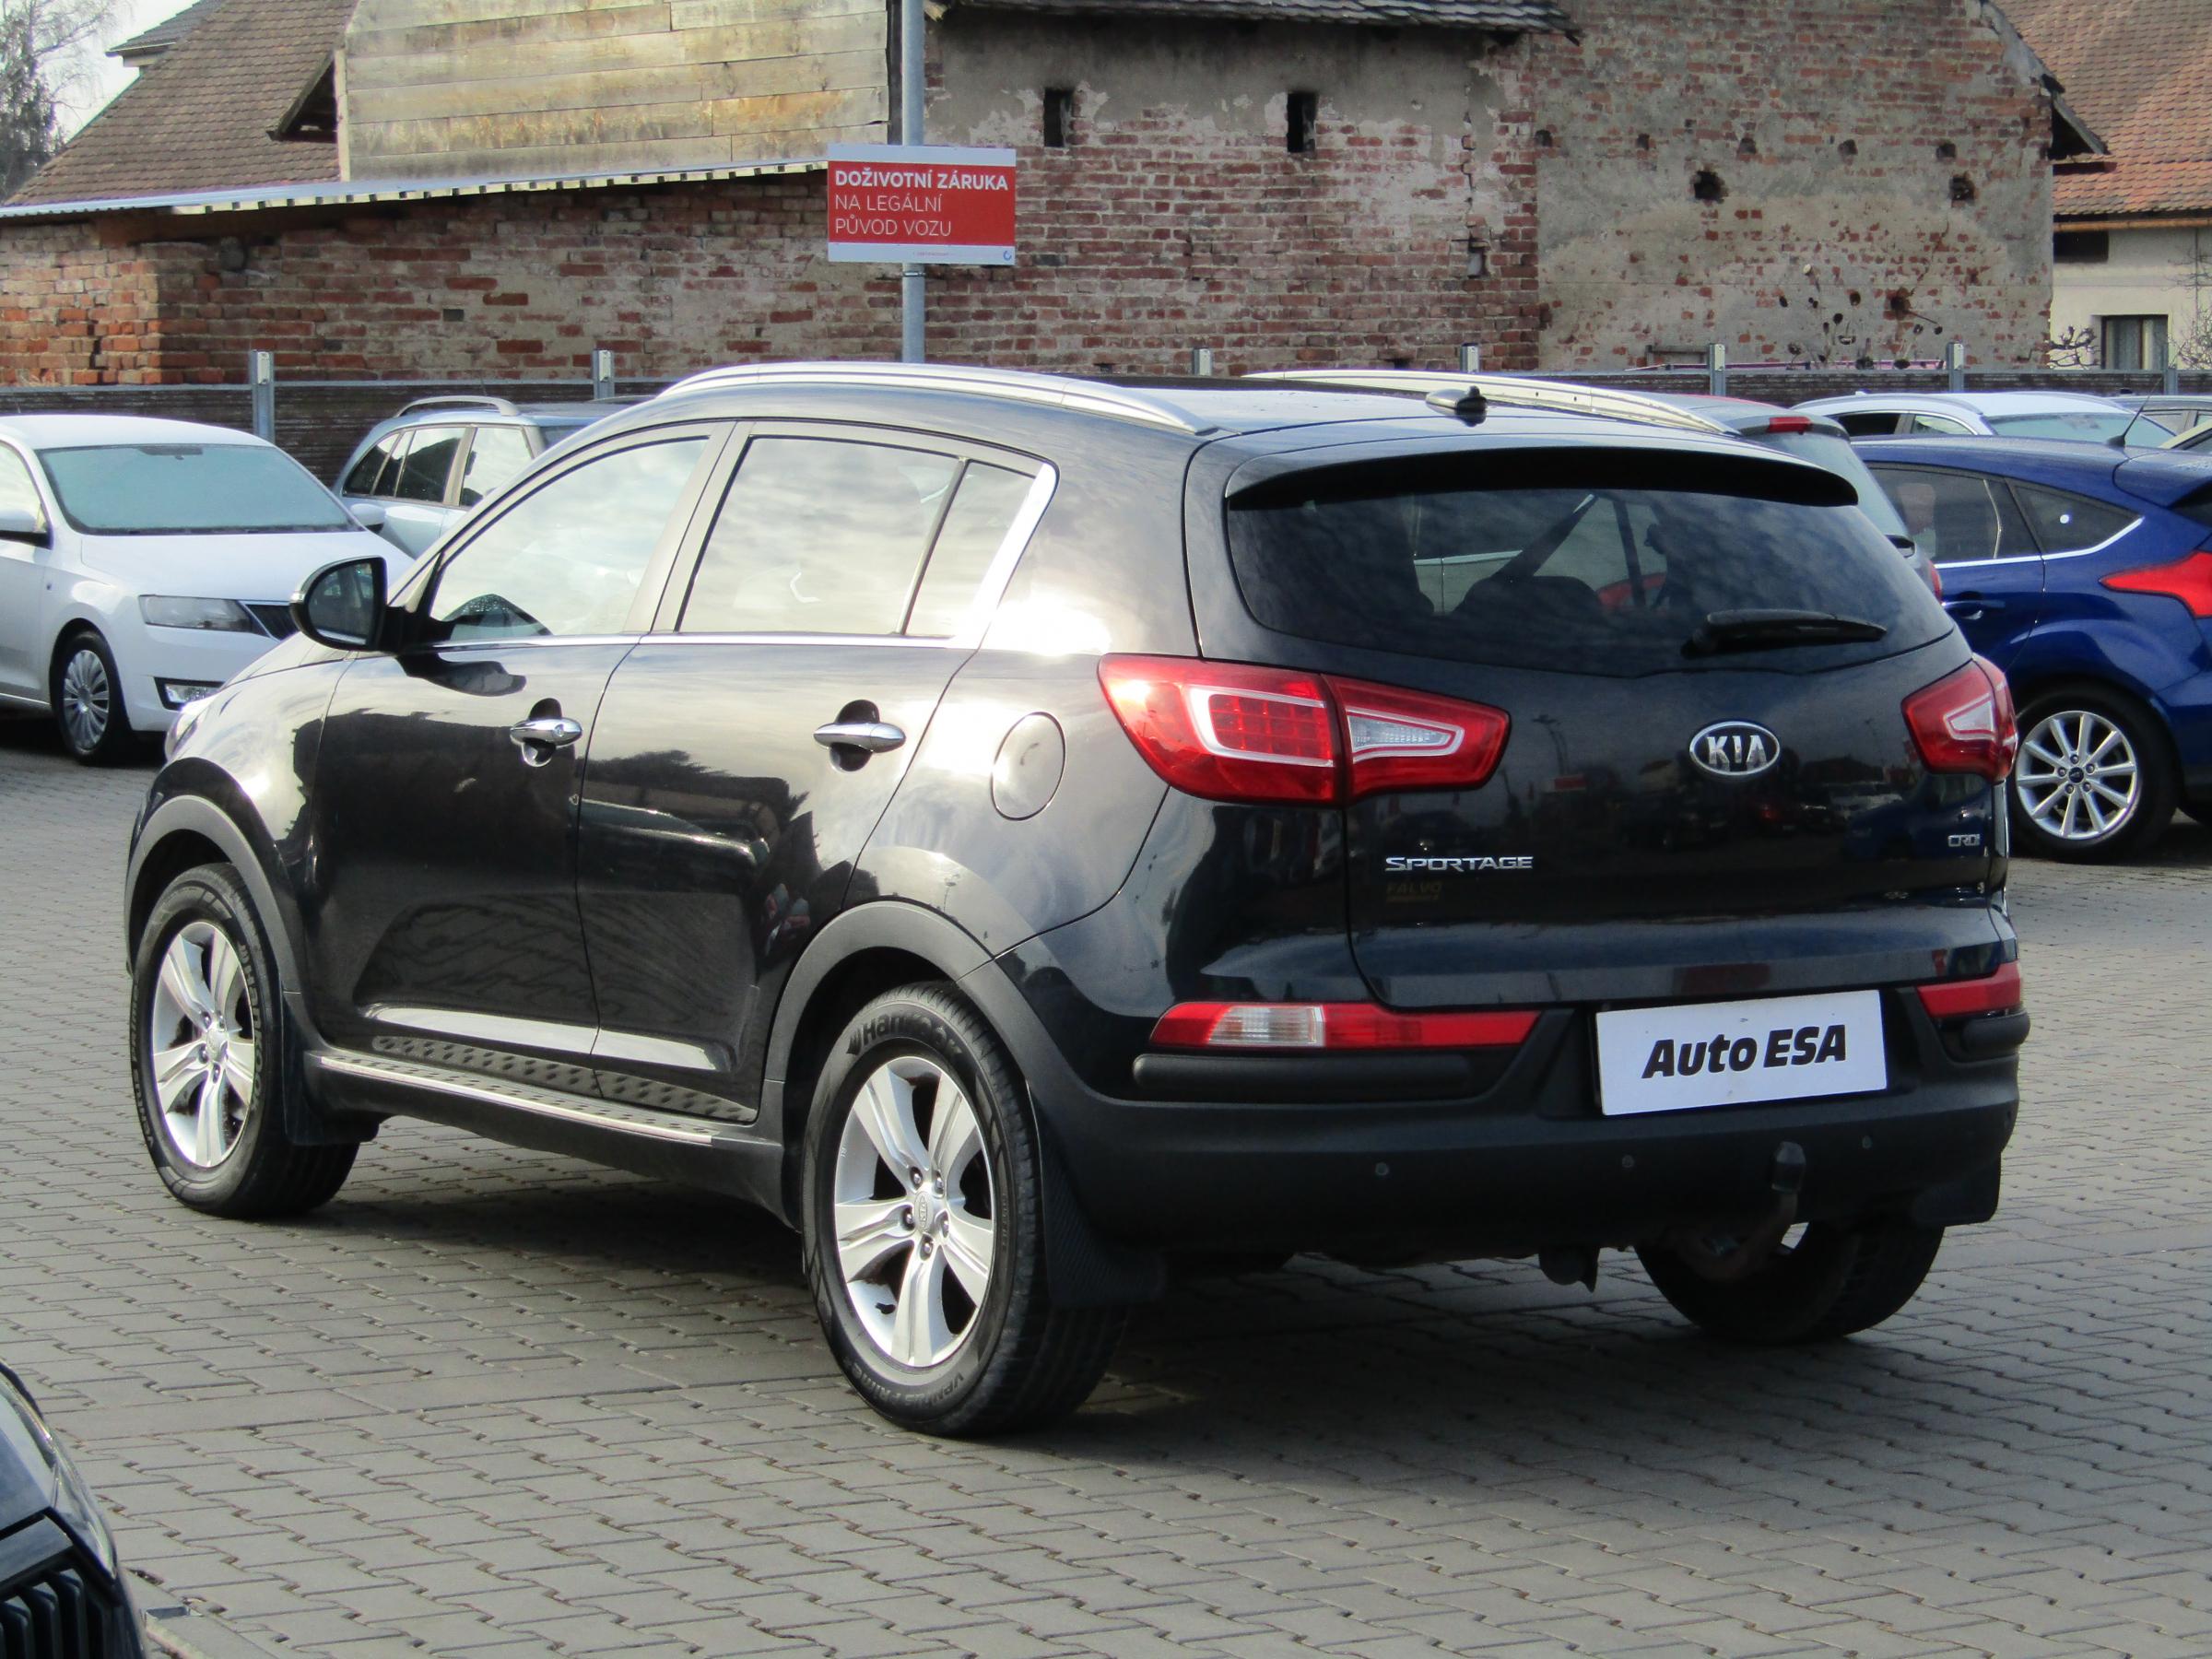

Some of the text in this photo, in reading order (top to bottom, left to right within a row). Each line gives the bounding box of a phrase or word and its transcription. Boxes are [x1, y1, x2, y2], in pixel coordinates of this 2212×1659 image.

[835, 167, 1008, 191] DOŽIVOTNÍ ZÁRUKA
[835, 193, 943, 212] NA LEGÁLNÍ
[835, 214, 951, 237] PŮVOD VOZU
[1706, 735, 1768, 771] KIA
[1385, 856, 1534, 872] SPORTAGE
[1641, 1024, 1846, 1078] Auto ESA
